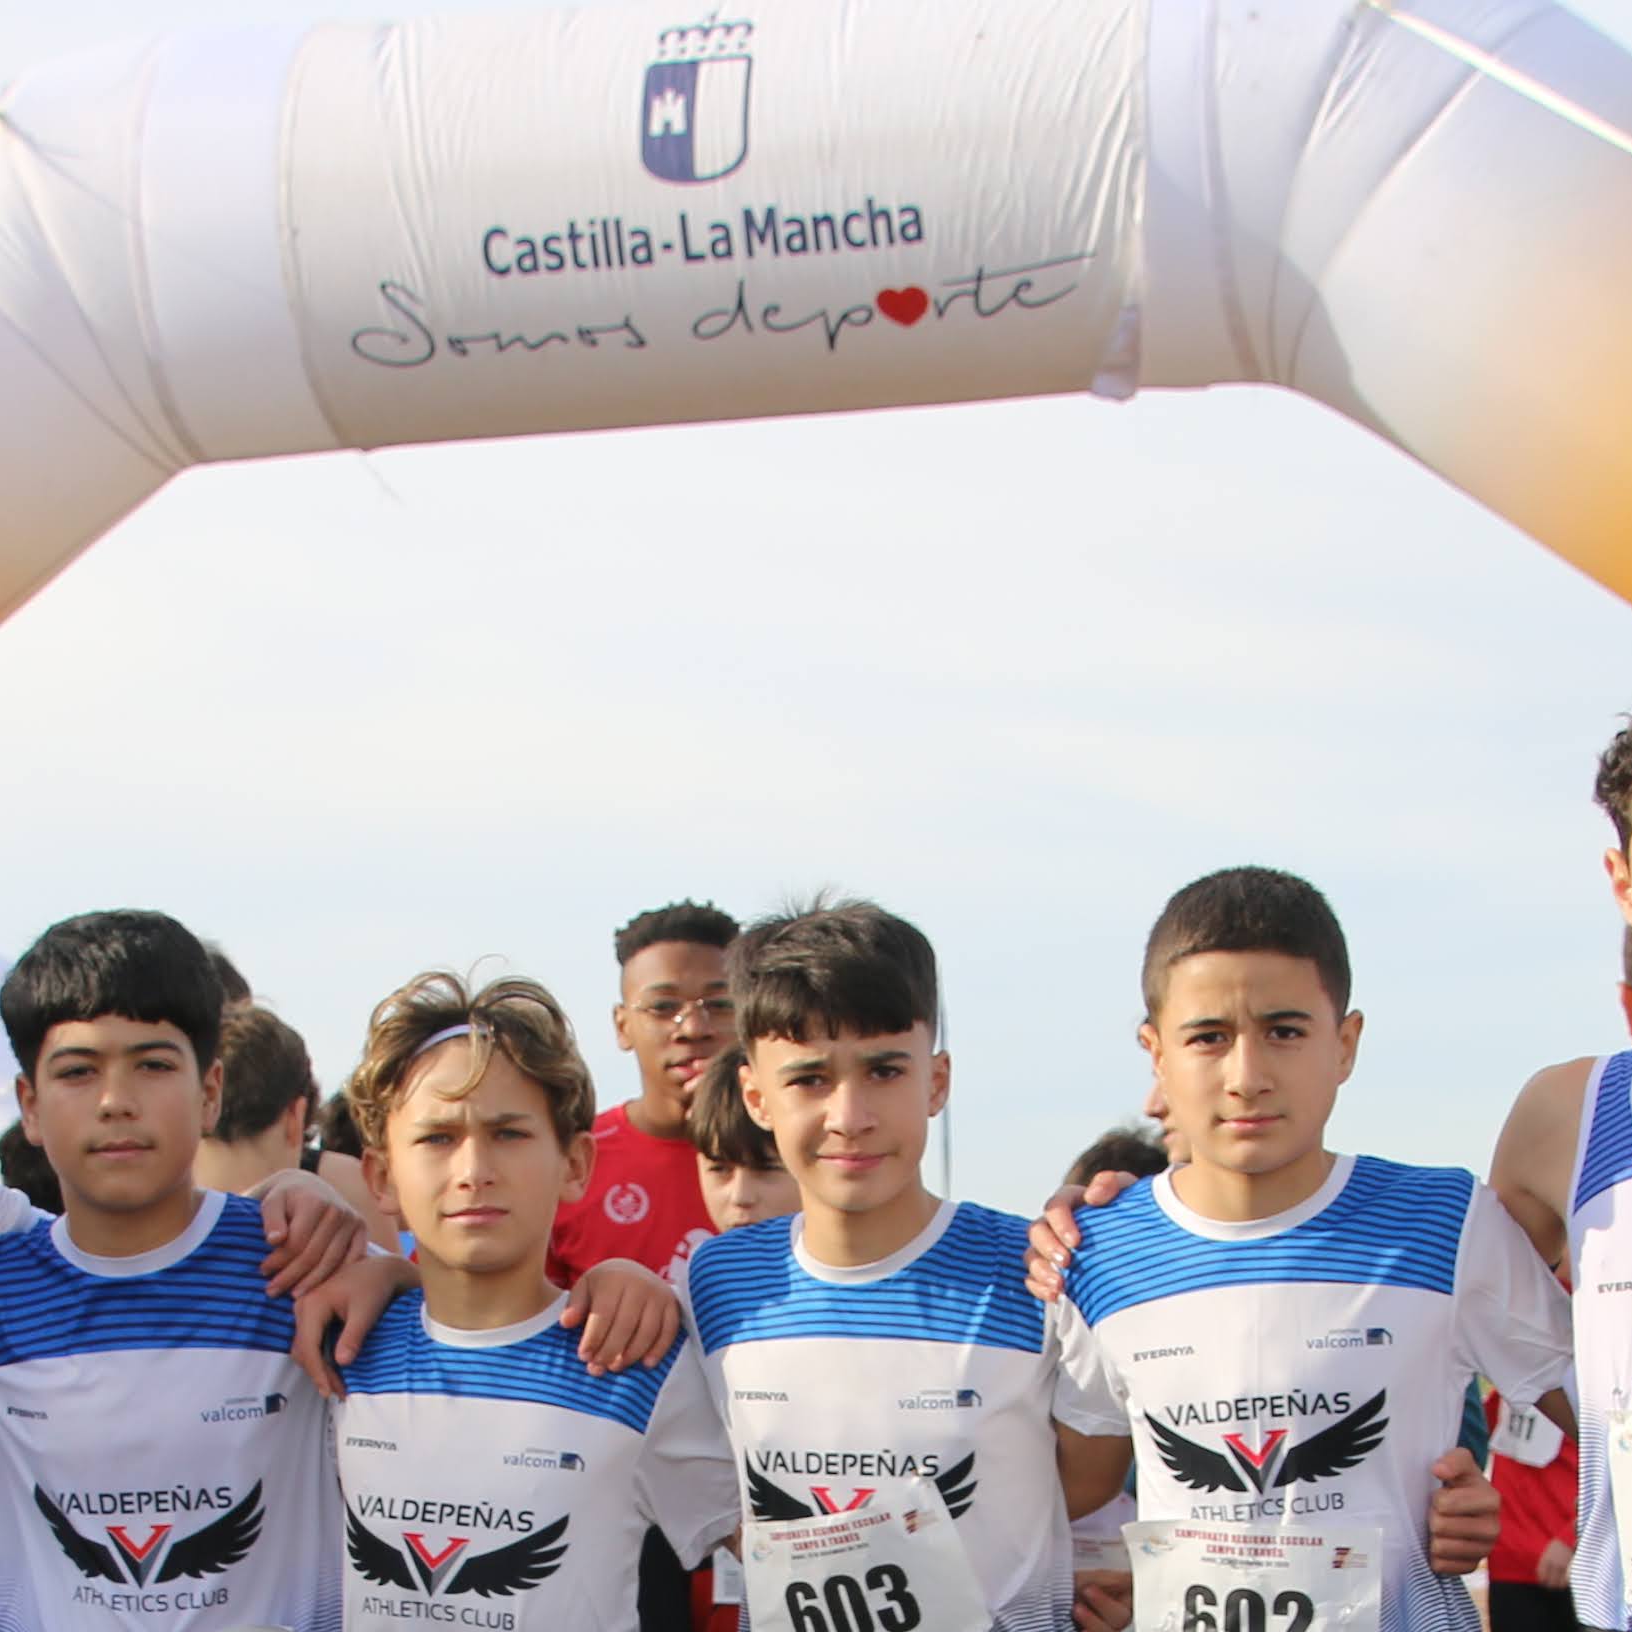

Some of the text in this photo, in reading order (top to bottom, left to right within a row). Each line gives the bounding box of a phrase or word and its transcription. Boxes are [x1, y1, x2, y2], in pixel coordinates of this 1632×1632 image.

[743, 197, 926, 258] Mancha
[352, 279, 648, 367] Somos
[1306, 1335, 1364, 1350] valcom
[201, 1402, 263, 1423] valcom
[897, 1394, 954, 1410] valcom
[1166, 1388, 1351, 1426] VALDEPEÑAS
[503, 1452, 557, 1470] valcom
[756, 1449, 939, 1478] VALDEPEÑAS
[357, 1494, 534, 1533] VALDEPEÑAS
[1191, 1492, 1345, 1521] ATHLETICS CLUB
[175, 1588, 229, 1611] CLUB
[362, 1595, 515, 1632] ATHLETICS CLUB
